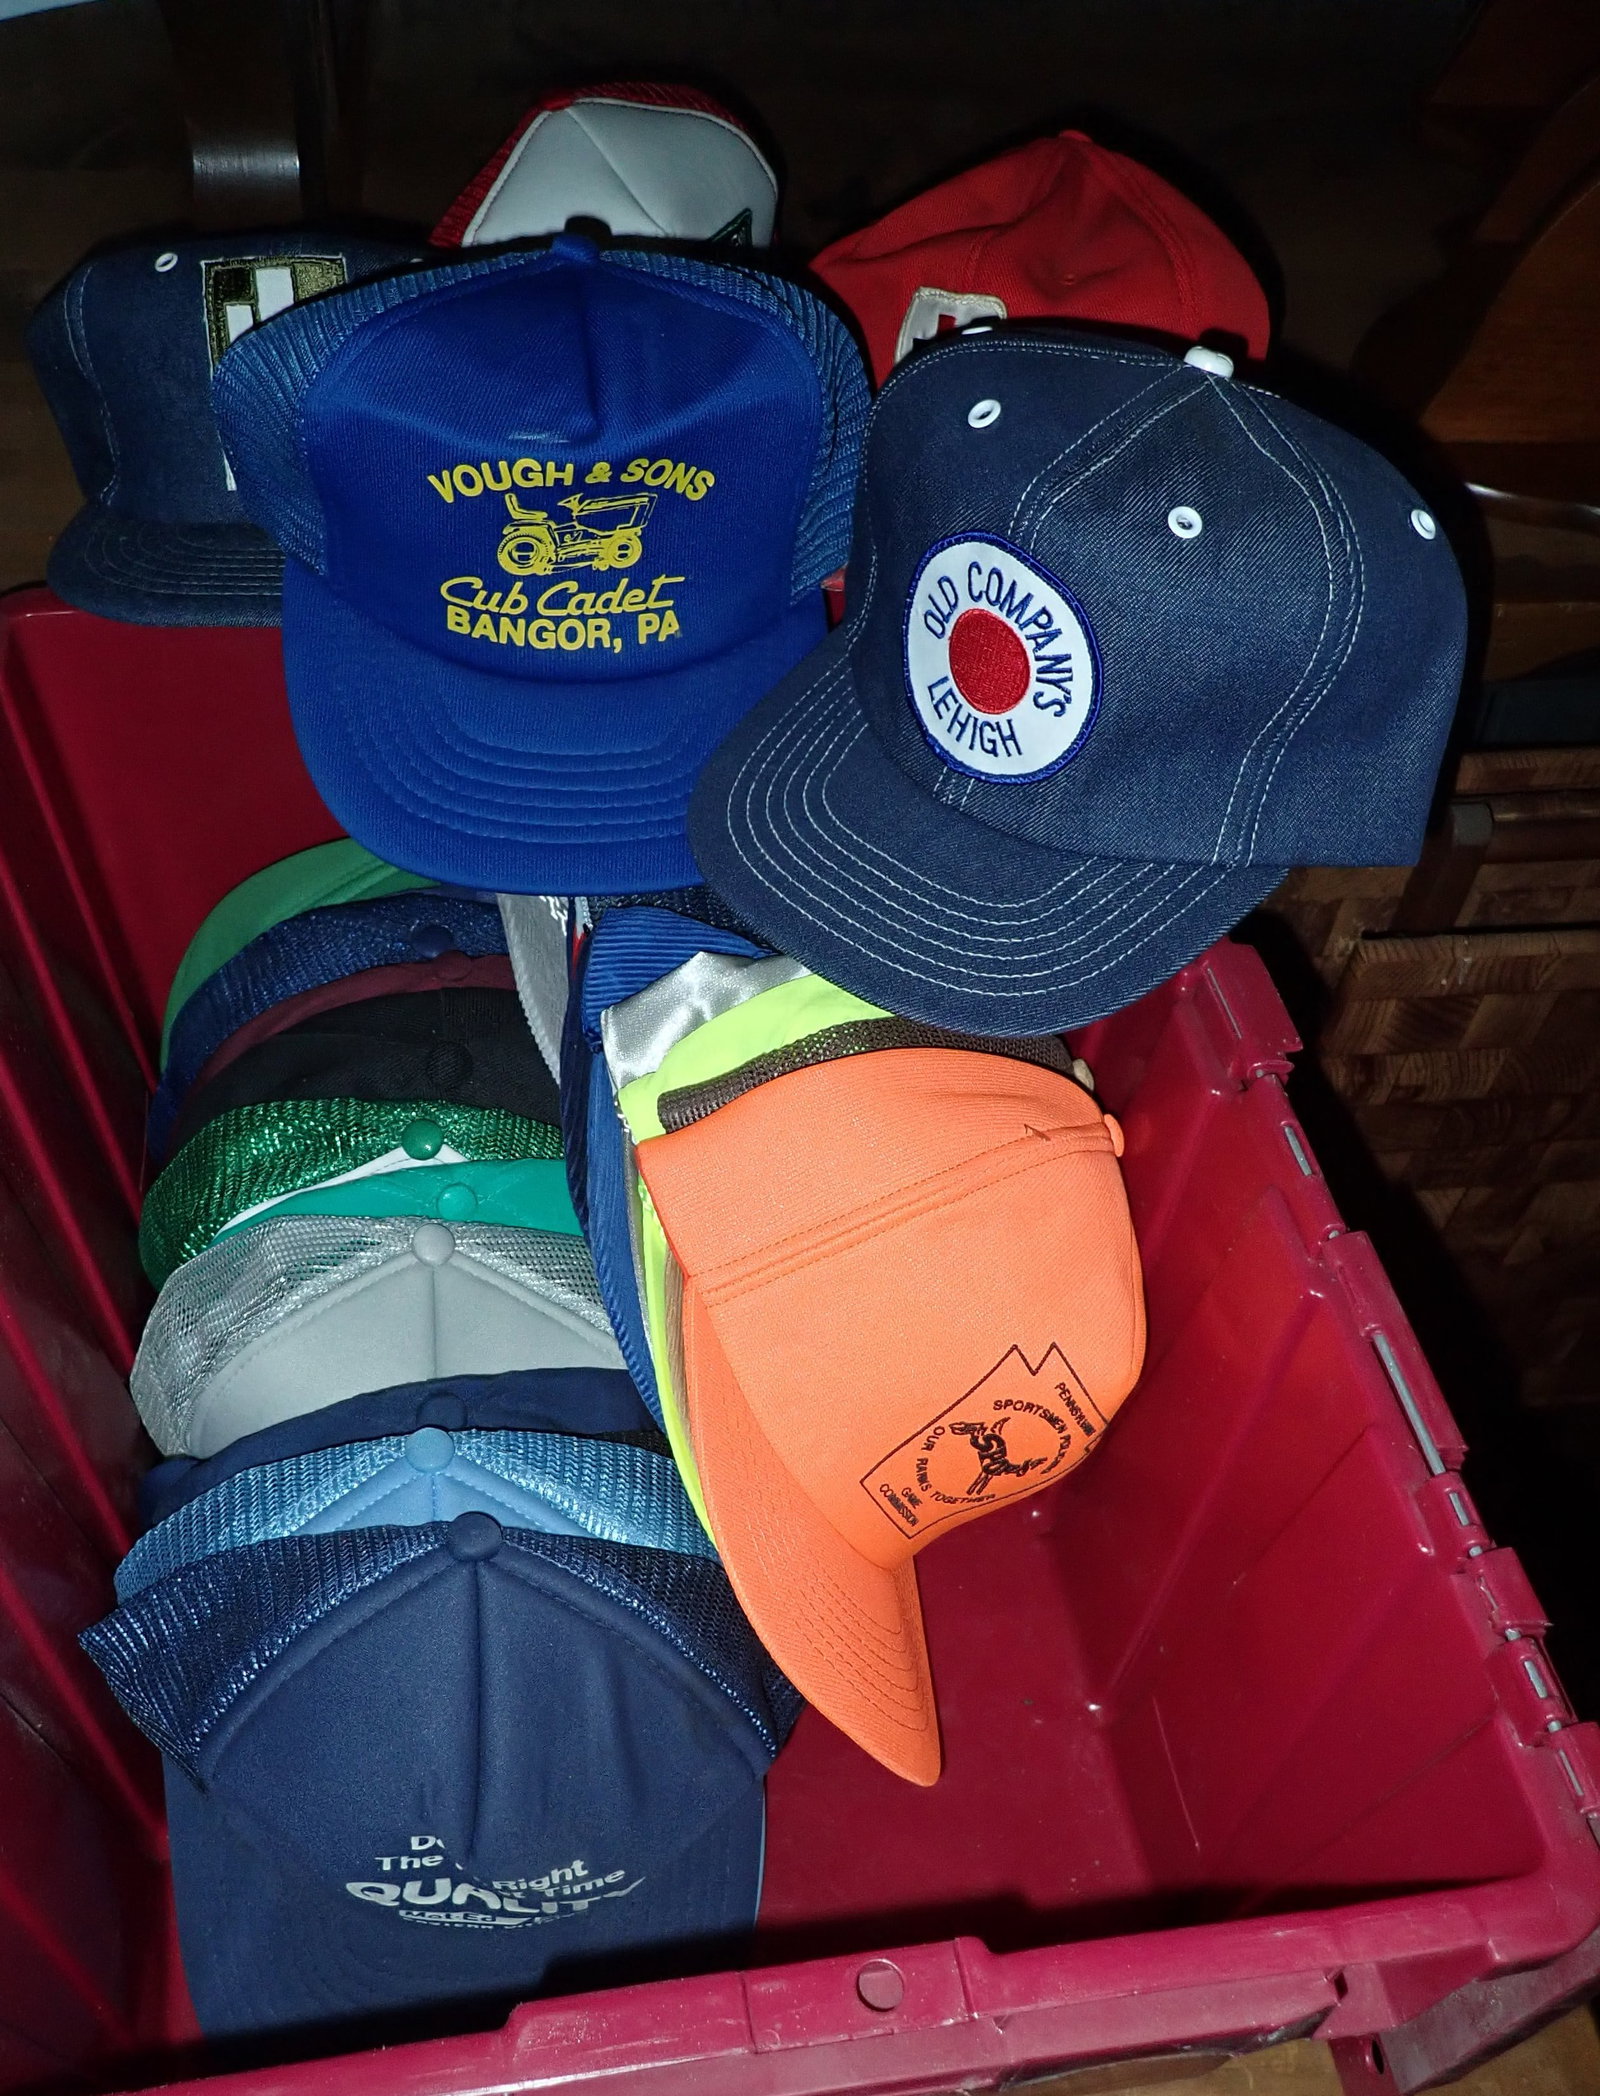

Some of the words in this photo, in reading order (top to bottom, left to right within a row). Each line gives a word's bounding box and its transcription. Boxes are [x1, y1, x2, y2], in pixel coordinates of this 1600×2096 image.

[427, 457, 574, 503] VOUGH
[585, 462, 613, 484] &
[620, 458, 715, 501] SONS
[440, 576, 528, 615] Cub
[537, 574, 685, 616] Cadet
[924, 575, 959, 640] OLD
[447, 605, 622, 653] BANGOR,
[638, 610, 681, 644] PA
[927, 676, 1023, 757] LEHIGH
[921, 1425, 946, 1452] OUR
[993, 1399, 1068, 1434] SPORTSMEN
[375, 1853, 444, 1871] The
[541, 1869, 626, 1897] Time
[492, 1859, 588, 1893] Right
